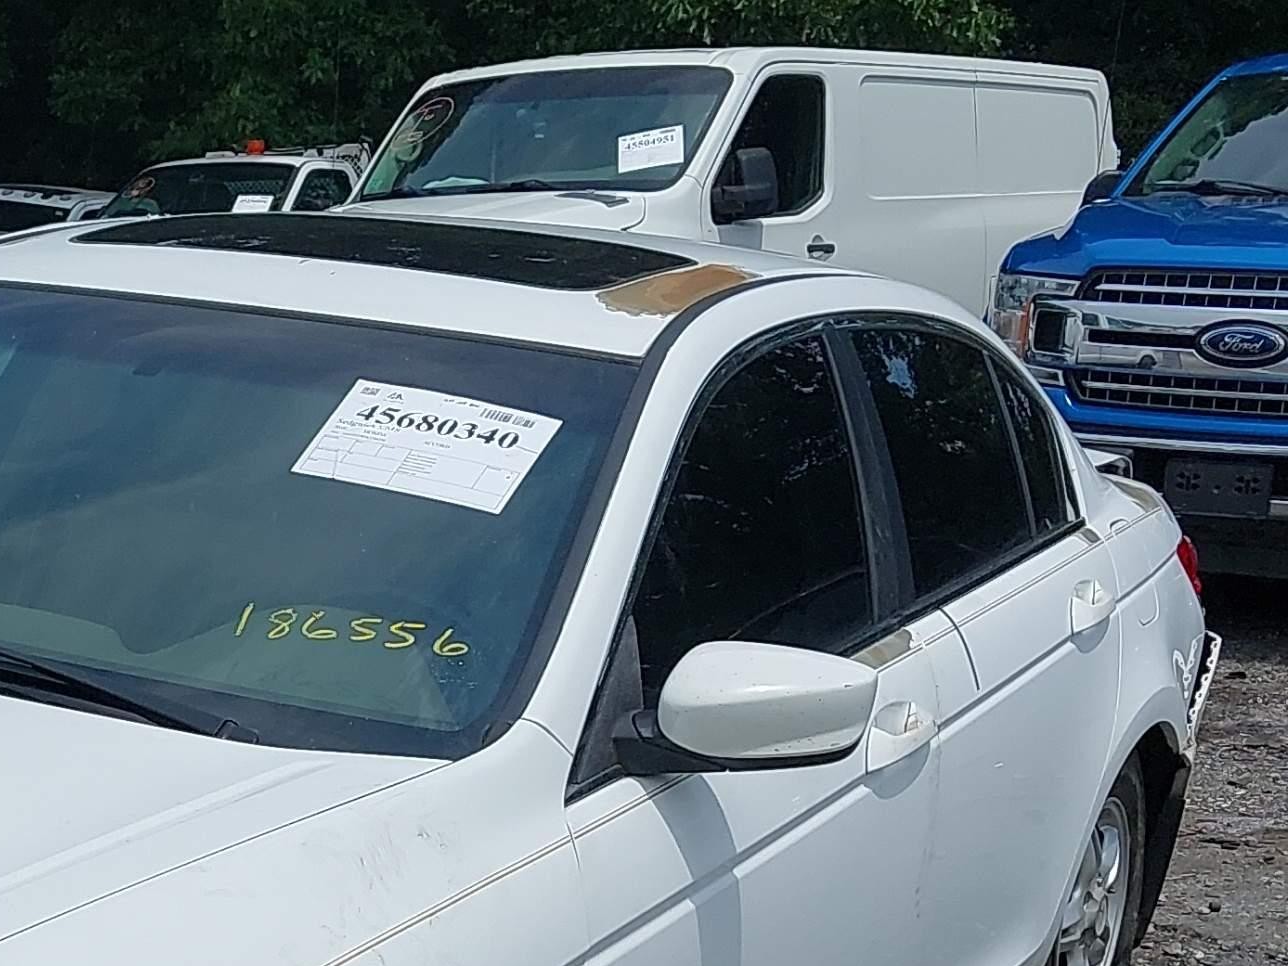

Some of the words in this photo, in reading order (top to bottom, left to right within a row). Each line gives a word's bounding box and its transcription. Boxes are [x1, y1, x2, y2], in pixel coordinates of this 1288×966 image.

[624, 134, 675, 150] 45504951
[1218, 333, 1265, 353] Ford
[356, 404, 520, 449] 45680340
[234, 602, 469, 656] 186556
